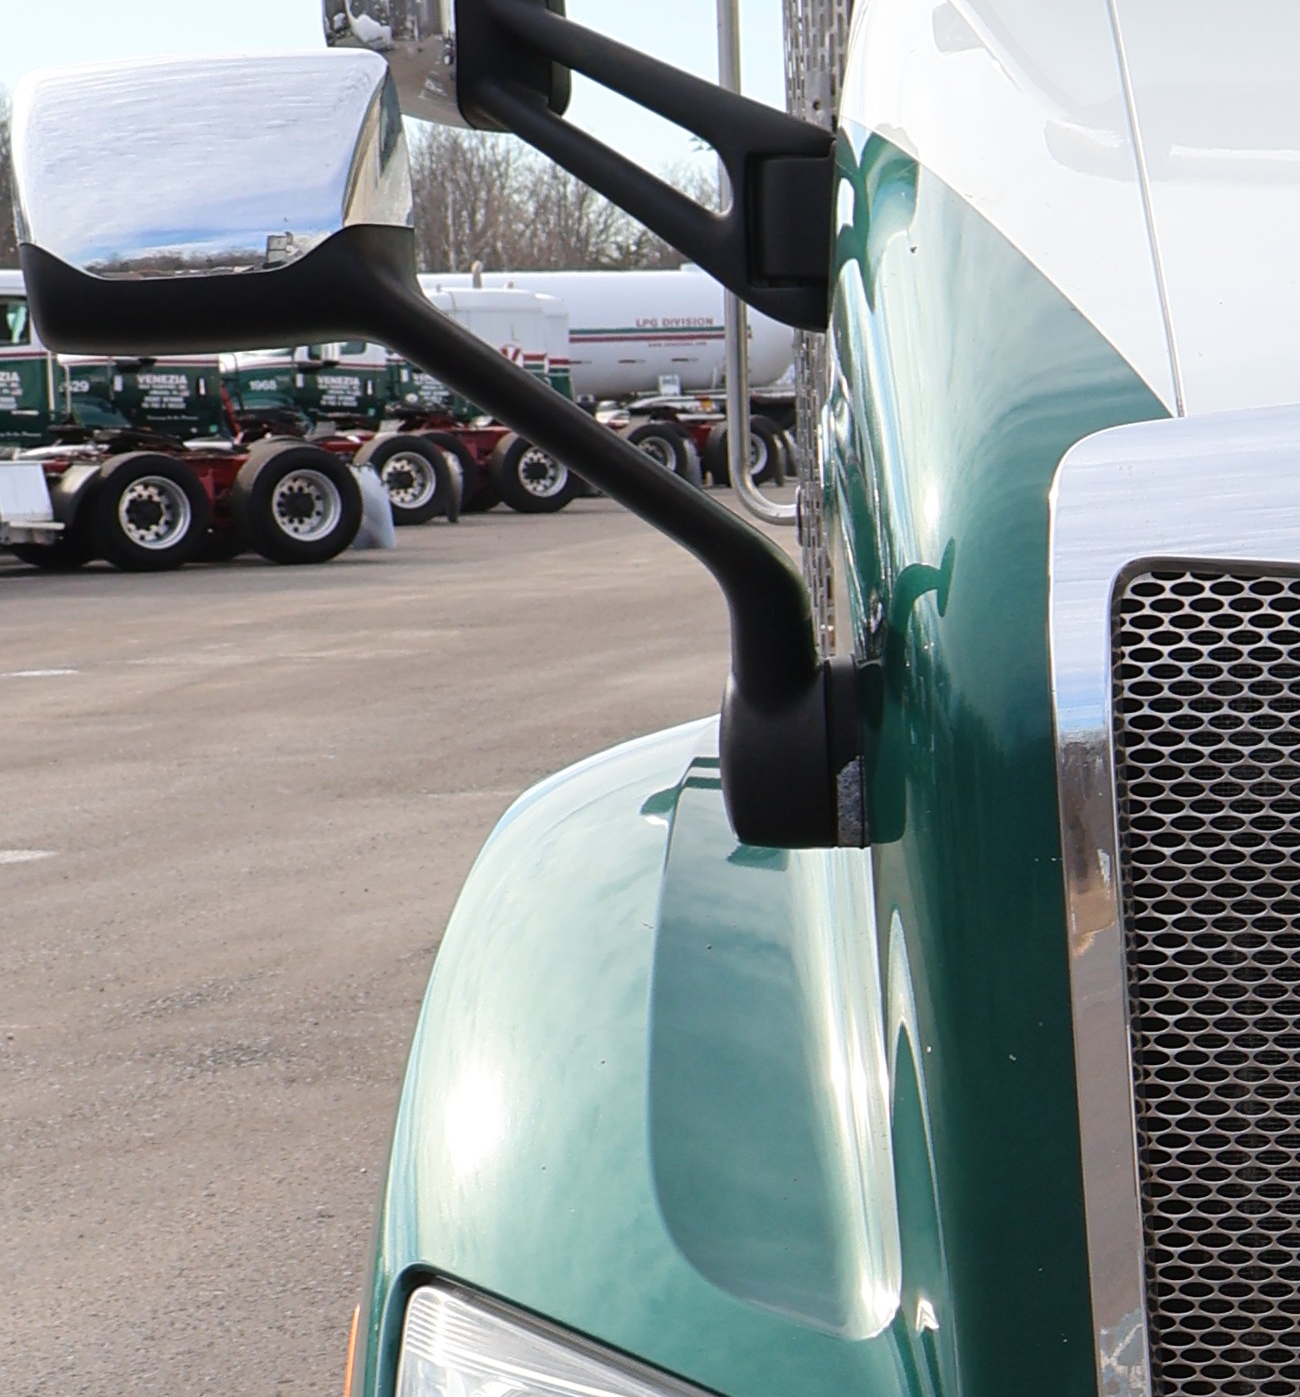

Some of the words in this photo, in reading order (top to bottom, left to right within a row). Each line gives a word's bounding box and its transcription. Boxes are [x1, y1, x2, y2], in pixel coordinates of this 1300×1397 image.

[636, 318, 658, 327] LPG
[662, 317, 713, 326] DIVISION
[137, 374, 188, 384] VENEZIA
[317, 376, 360, 385] VENEZIA
